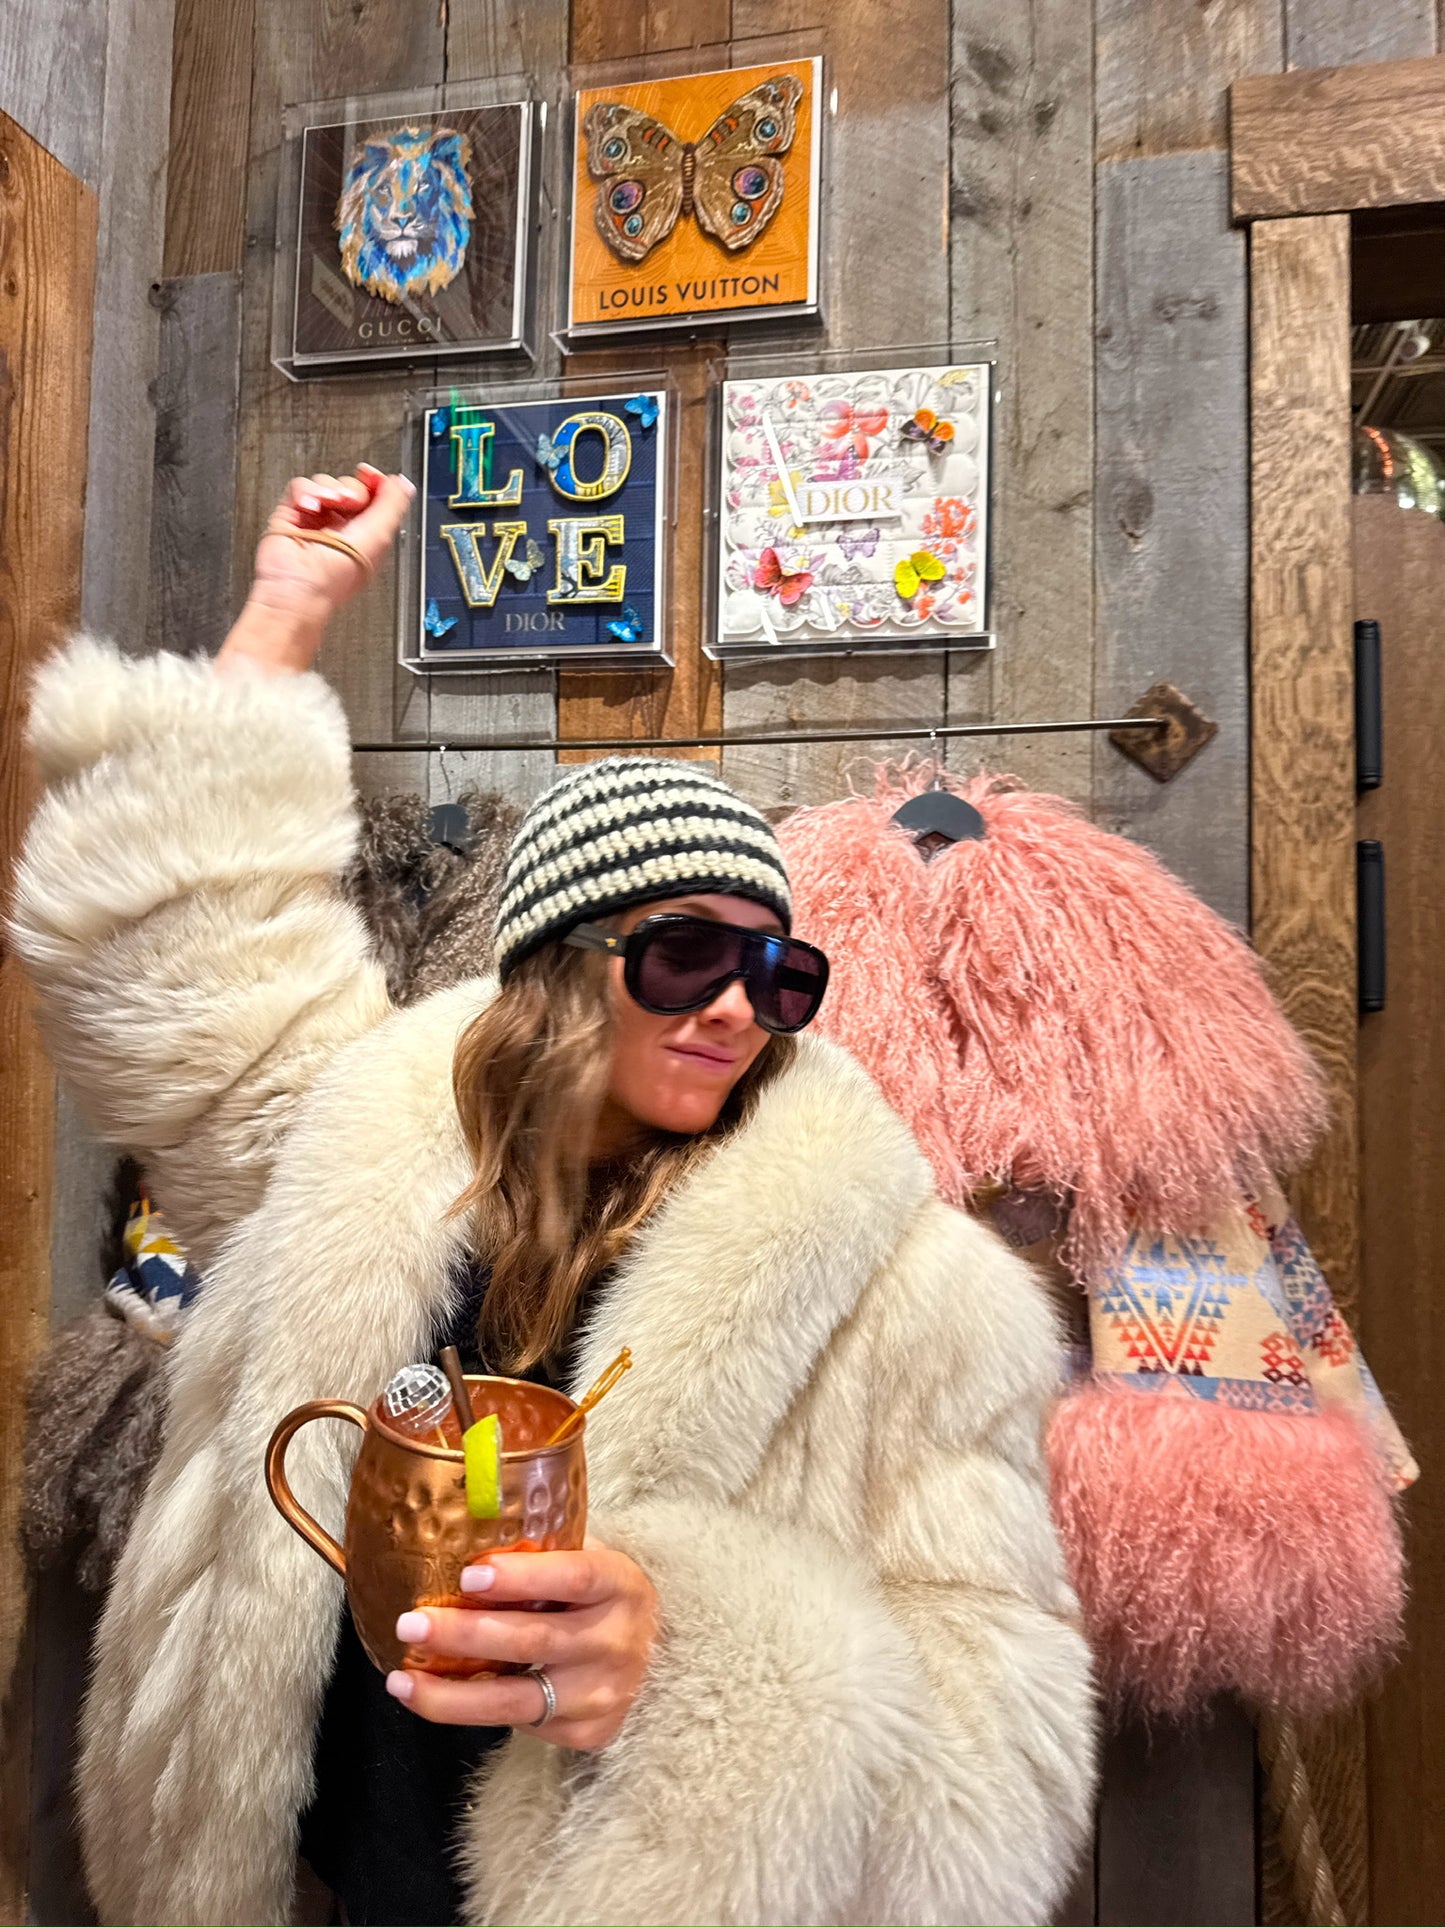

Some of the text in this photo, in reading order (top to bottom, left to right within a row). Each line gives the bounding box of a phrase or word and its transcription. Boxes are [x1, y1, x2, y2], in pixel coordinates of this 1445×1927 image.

[600, 273, 780, 309] LOUIS VUITTON
[358, 317, 441, 339] GUCCI
[806, 486, 894, 516] DIOR
[505, 611, 566, 633] DIOR
